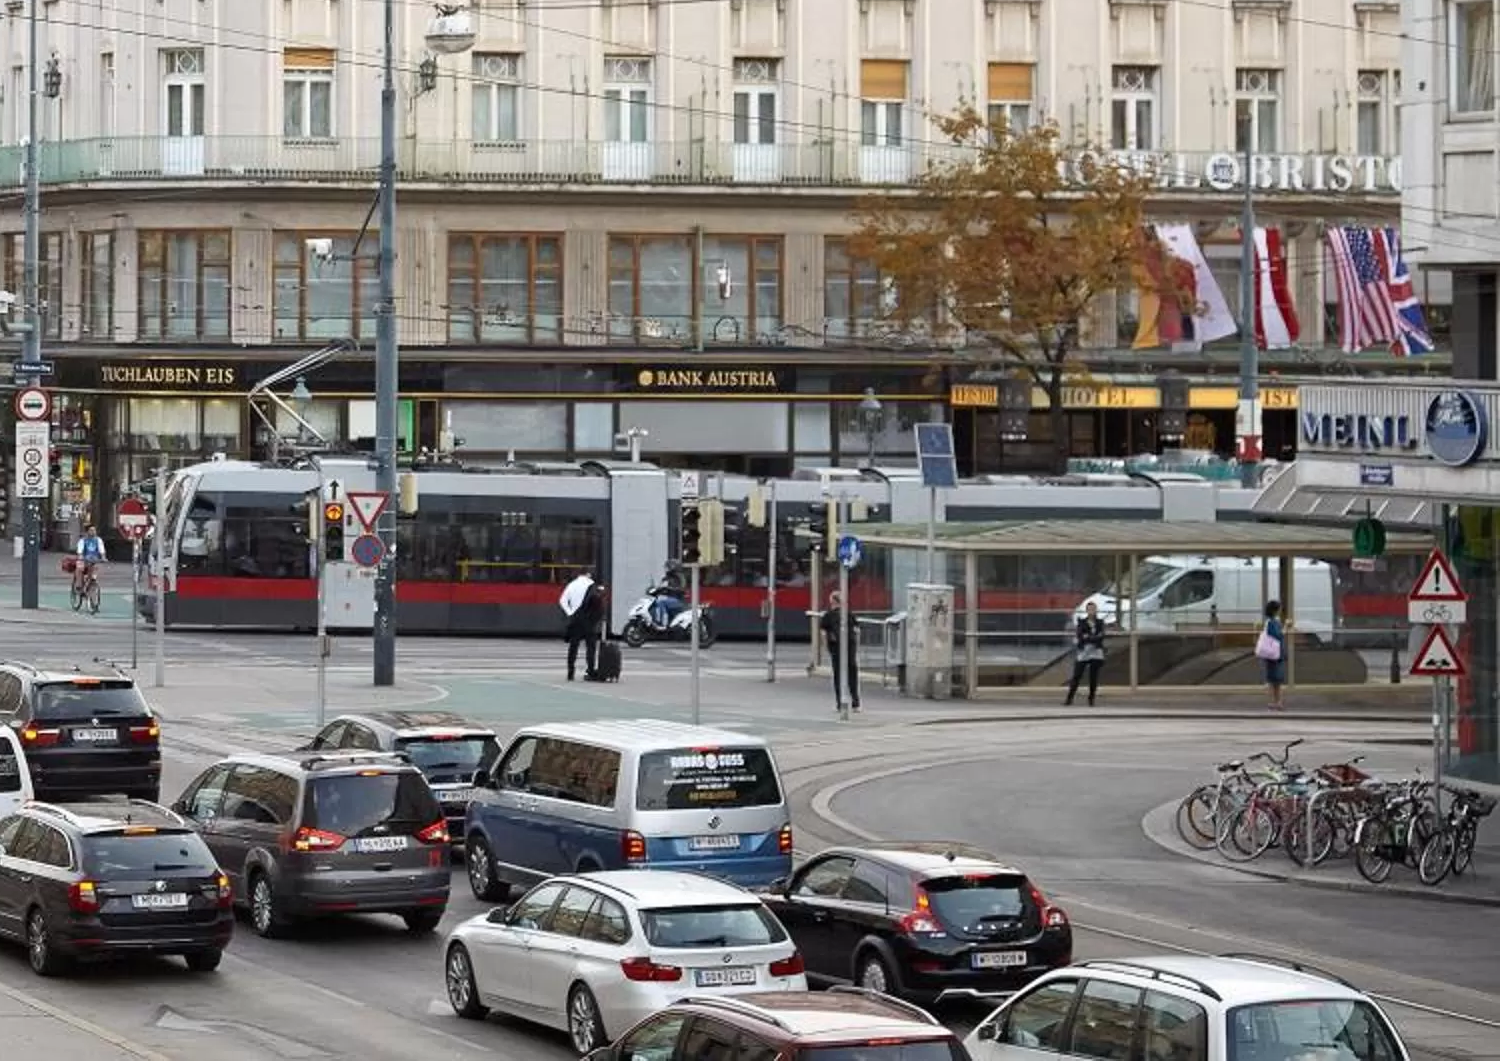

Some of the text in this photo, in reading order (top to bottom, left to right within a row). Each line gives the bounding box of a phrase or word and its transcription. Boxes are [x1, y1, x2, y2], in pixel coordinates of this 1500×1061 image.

[100, 366, 235, 384] TUCHLAUBEN EIS
[656, 370, 777, 387] BANK AUSTRIA
[1062, 388, 1135, 406] HOTEL
